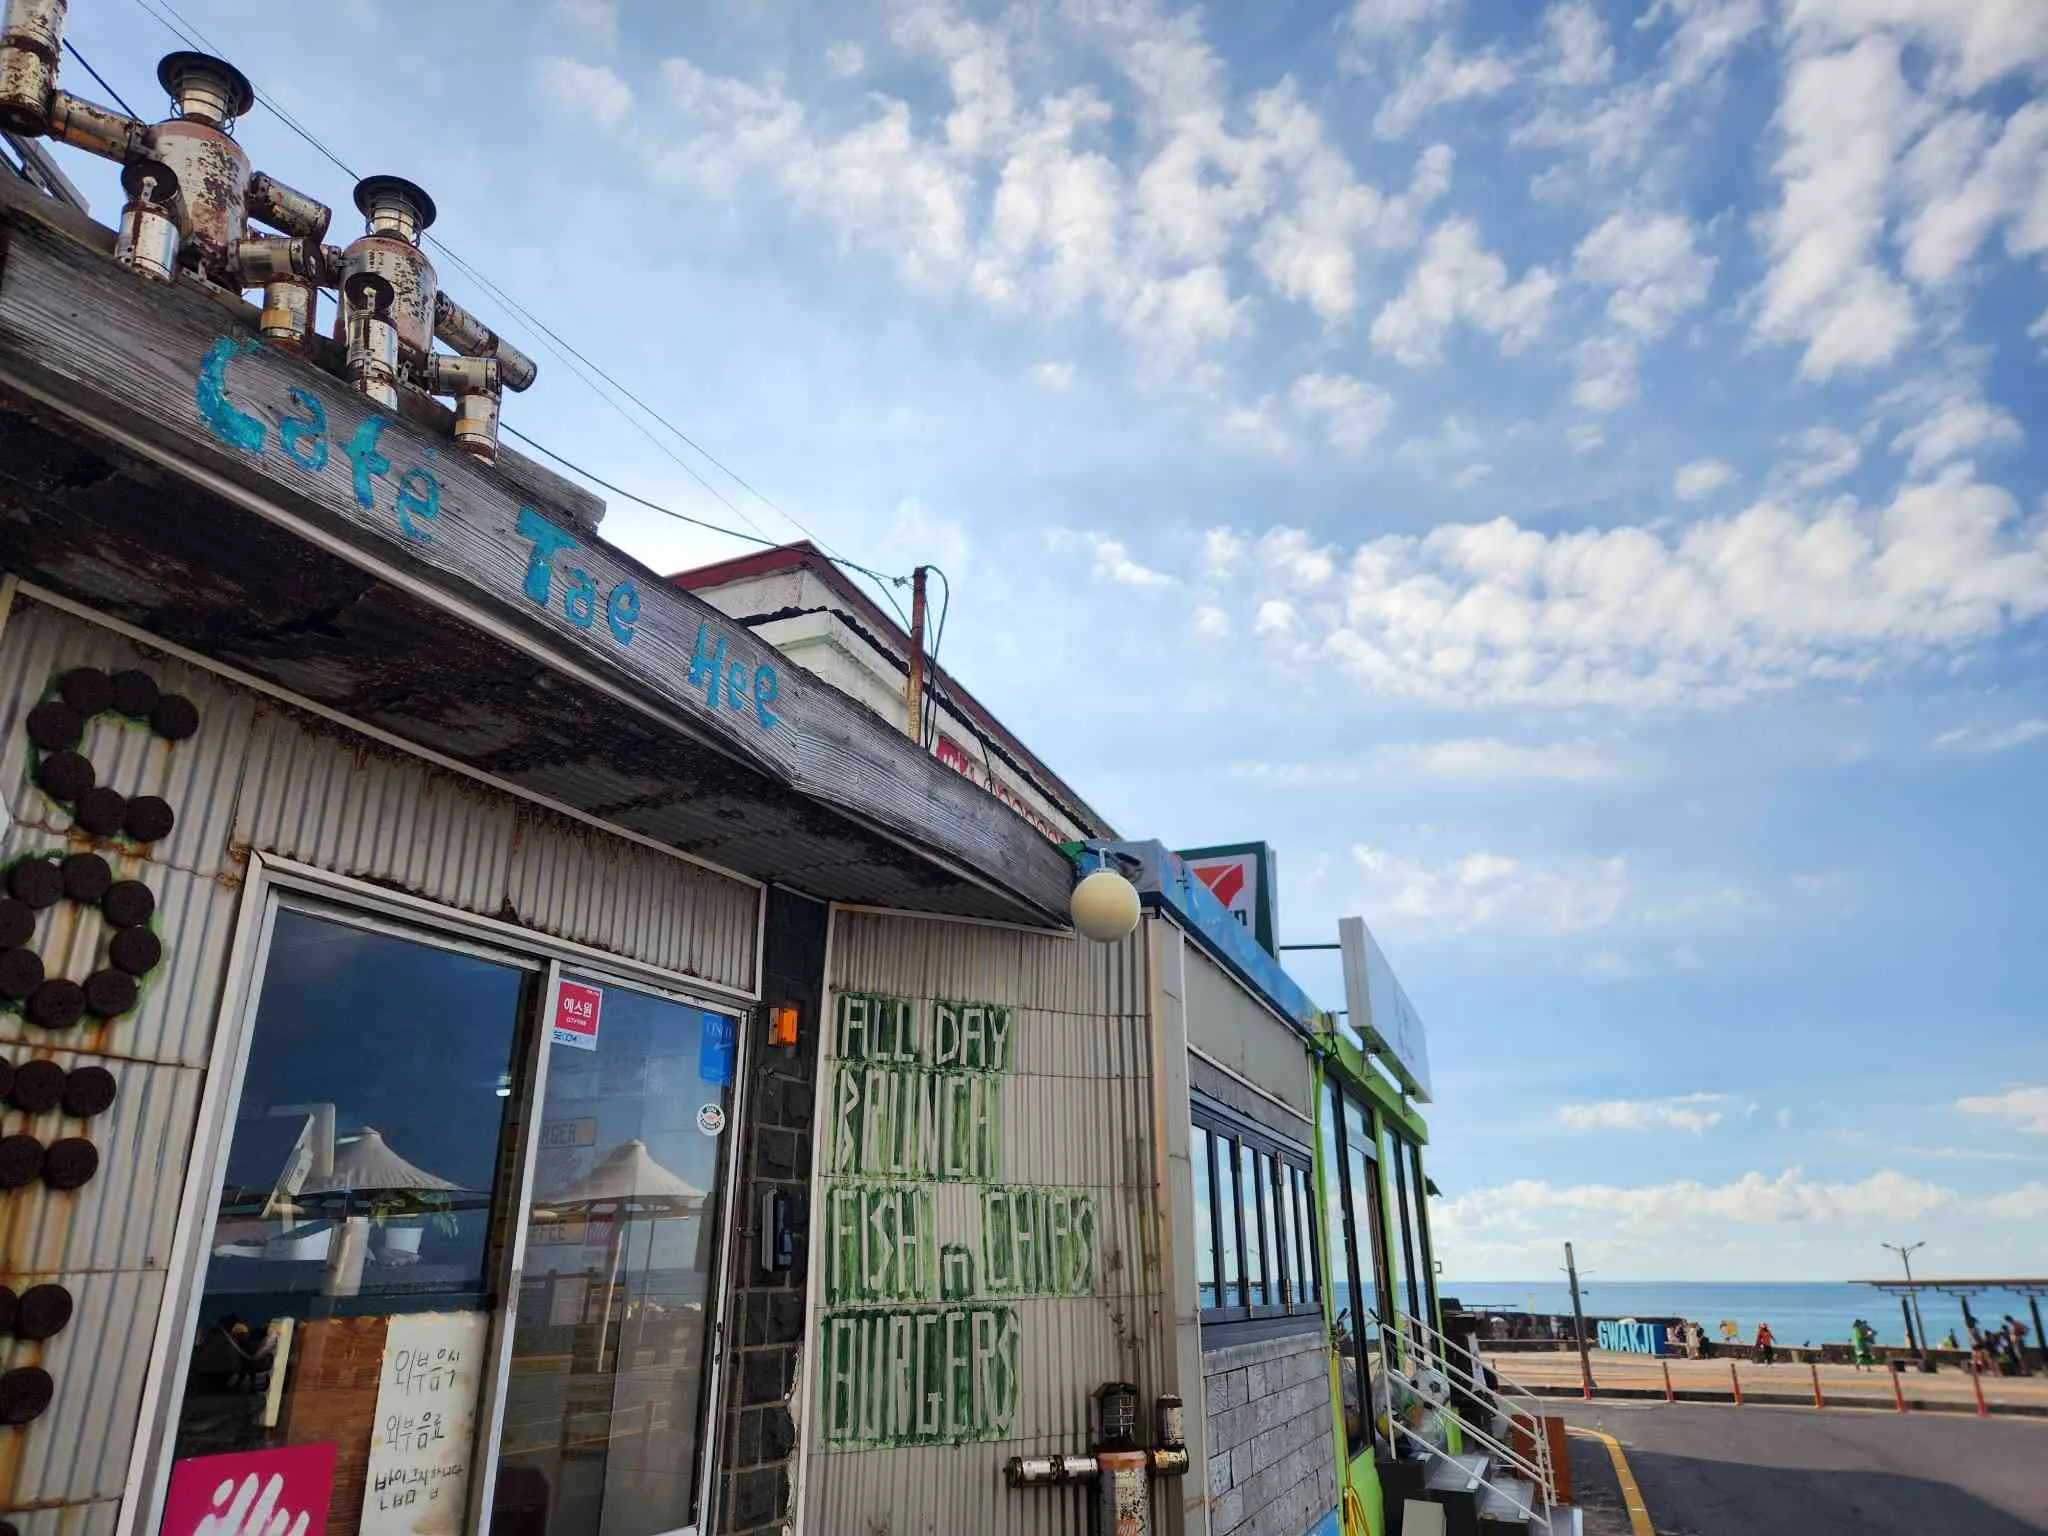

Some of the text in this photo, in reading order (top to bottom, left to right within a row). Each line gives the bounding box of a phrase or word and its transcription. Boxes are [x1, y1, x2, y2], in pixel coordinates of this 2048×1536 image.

[516, 507, 640, 645] Tae
[688, 620, 778, 729] Hee
[563, 997, 593, 1018] 에스원
[842, 998, 1010, 1071] ALL DAY
[838, 1068, 994, 1175] BRUNCH
[832, 1189, 924, 1293] FISH
[986, 1190, 1096, 1294] CHIPS
[829, 1310, 1018, 1437] BURGERS
[1597, 1320, 1656, 1355] GWAKJI
